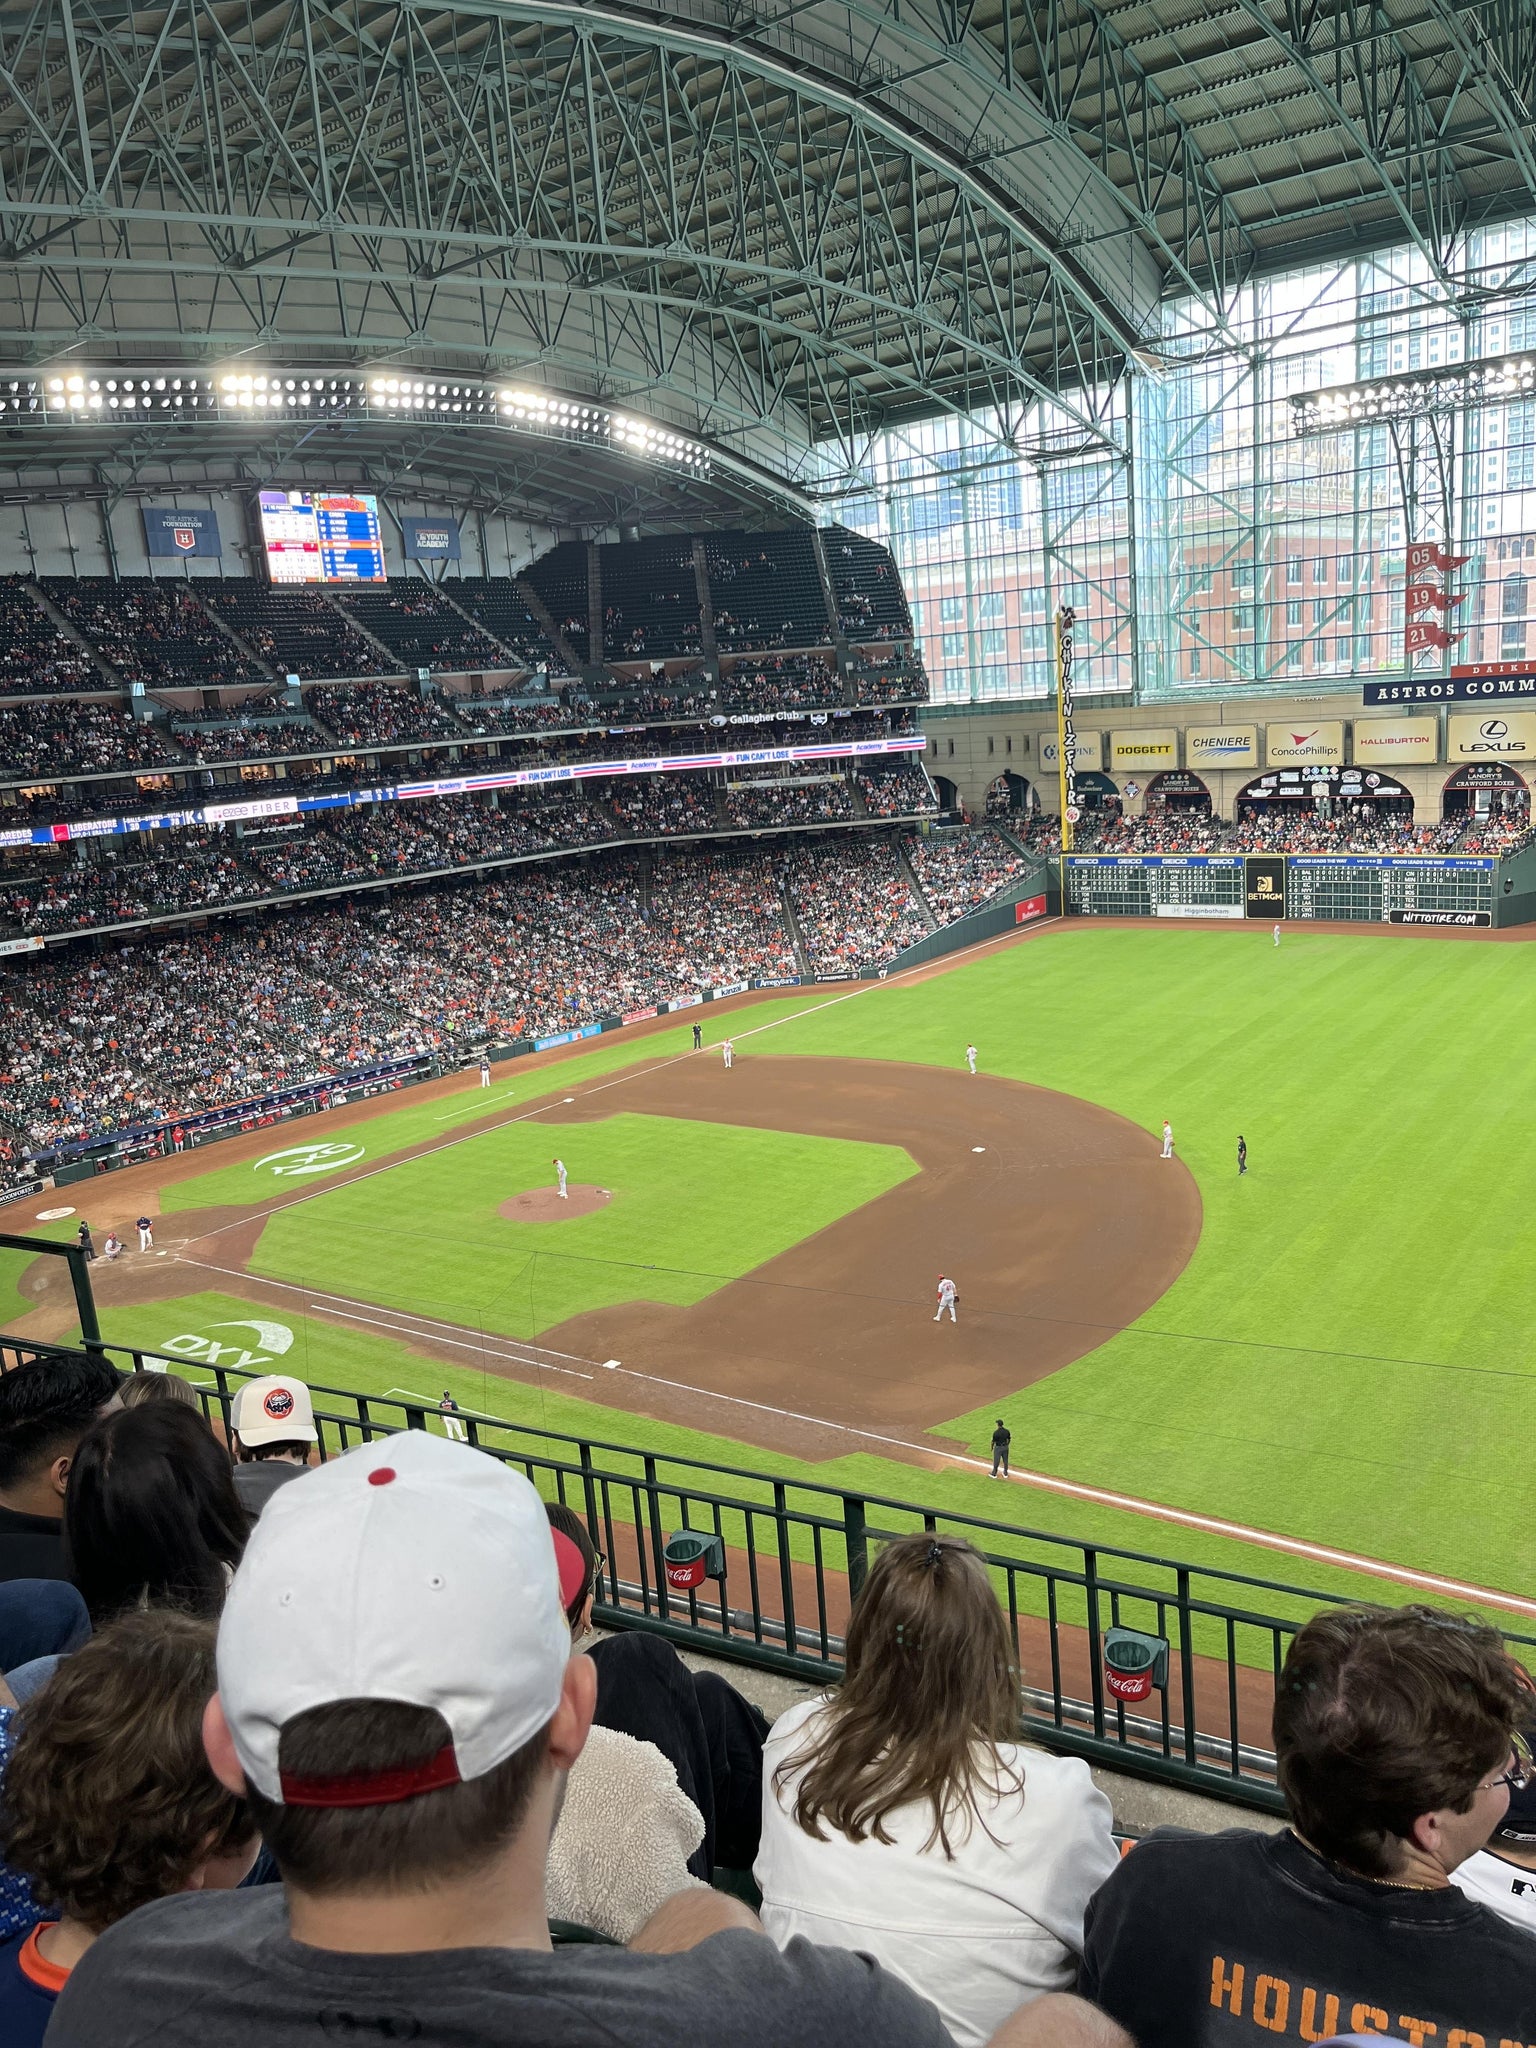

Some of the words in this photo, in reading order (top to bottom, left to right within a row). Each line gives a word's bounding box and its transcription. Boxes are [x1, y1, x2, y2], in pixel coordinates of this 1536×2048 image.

[426, 533, 449, 541] YOUTH
[416, 540, 450, 548] ACADEMY
[1411, 549, 1430, 565] 05
[1412, 590, 1429, 606] 19
[1410, 628, 1427, 643] 21
[1473, 664, 1530, 674] DAIKI
[1061, 636, 1073, 717] CHIKIN
[1377, 684, 1455, 700] ASTROS
[1466, 679, 1536, 696] COMM
[730, 713, 775, 726] Gallagher
[775, 711, 799, 721] Club
[1064, 719, 1077, 747] IZ
[856, 743, 883, 751] Academy
[1193, 736, 1251, 748] CHENIERE
[1360, 736, 1430, 746] HALLIBURTON
[1460, 741, 1526, 753] LEXUS
[736, 754, 749, 762] FUN
[751, 752, 769, 760] CAN'T
[772, 750, 789, 759] LOSE
[1117, 745, 1171, 755] DOGGETT
[1271, 746, 1338, 757] ConocoPhillips
[631, 761, 658, 770] Academy
[528, 773, 540, 781] FUN
[540, 771, 556, 780] CAN'T
[557, 769, 571, 778] LOSE
[1064, 750, 1077, 805] FAIR
[438, 782, 462, 791] Academy
[1456, 780, 1493, 788] CRAWFORD
[222, 806, 249, 819] ezee
[252, 802, 290, 814] FIBER
[185, 810, 196, 825] K
[70, 819, 118, 831] LIBERATORE
[1048, 857, 1060, 865] 315
[1248, 893, 1283, 901] BETMGM
[1184, 907, 1230, 915] Higginbotham
[1402, 911, 1477, 925] NITTOTIRE.COM
[0, 1185, 35, 1202] OODFOREST
[160, 1334, 274, 1369] OXY
[266, 1398, 292, 1413] Astros
[1106, 1671, 1145, 1693] Coca-Cola
[1210, 1955, 1536, 2048] HOUST
